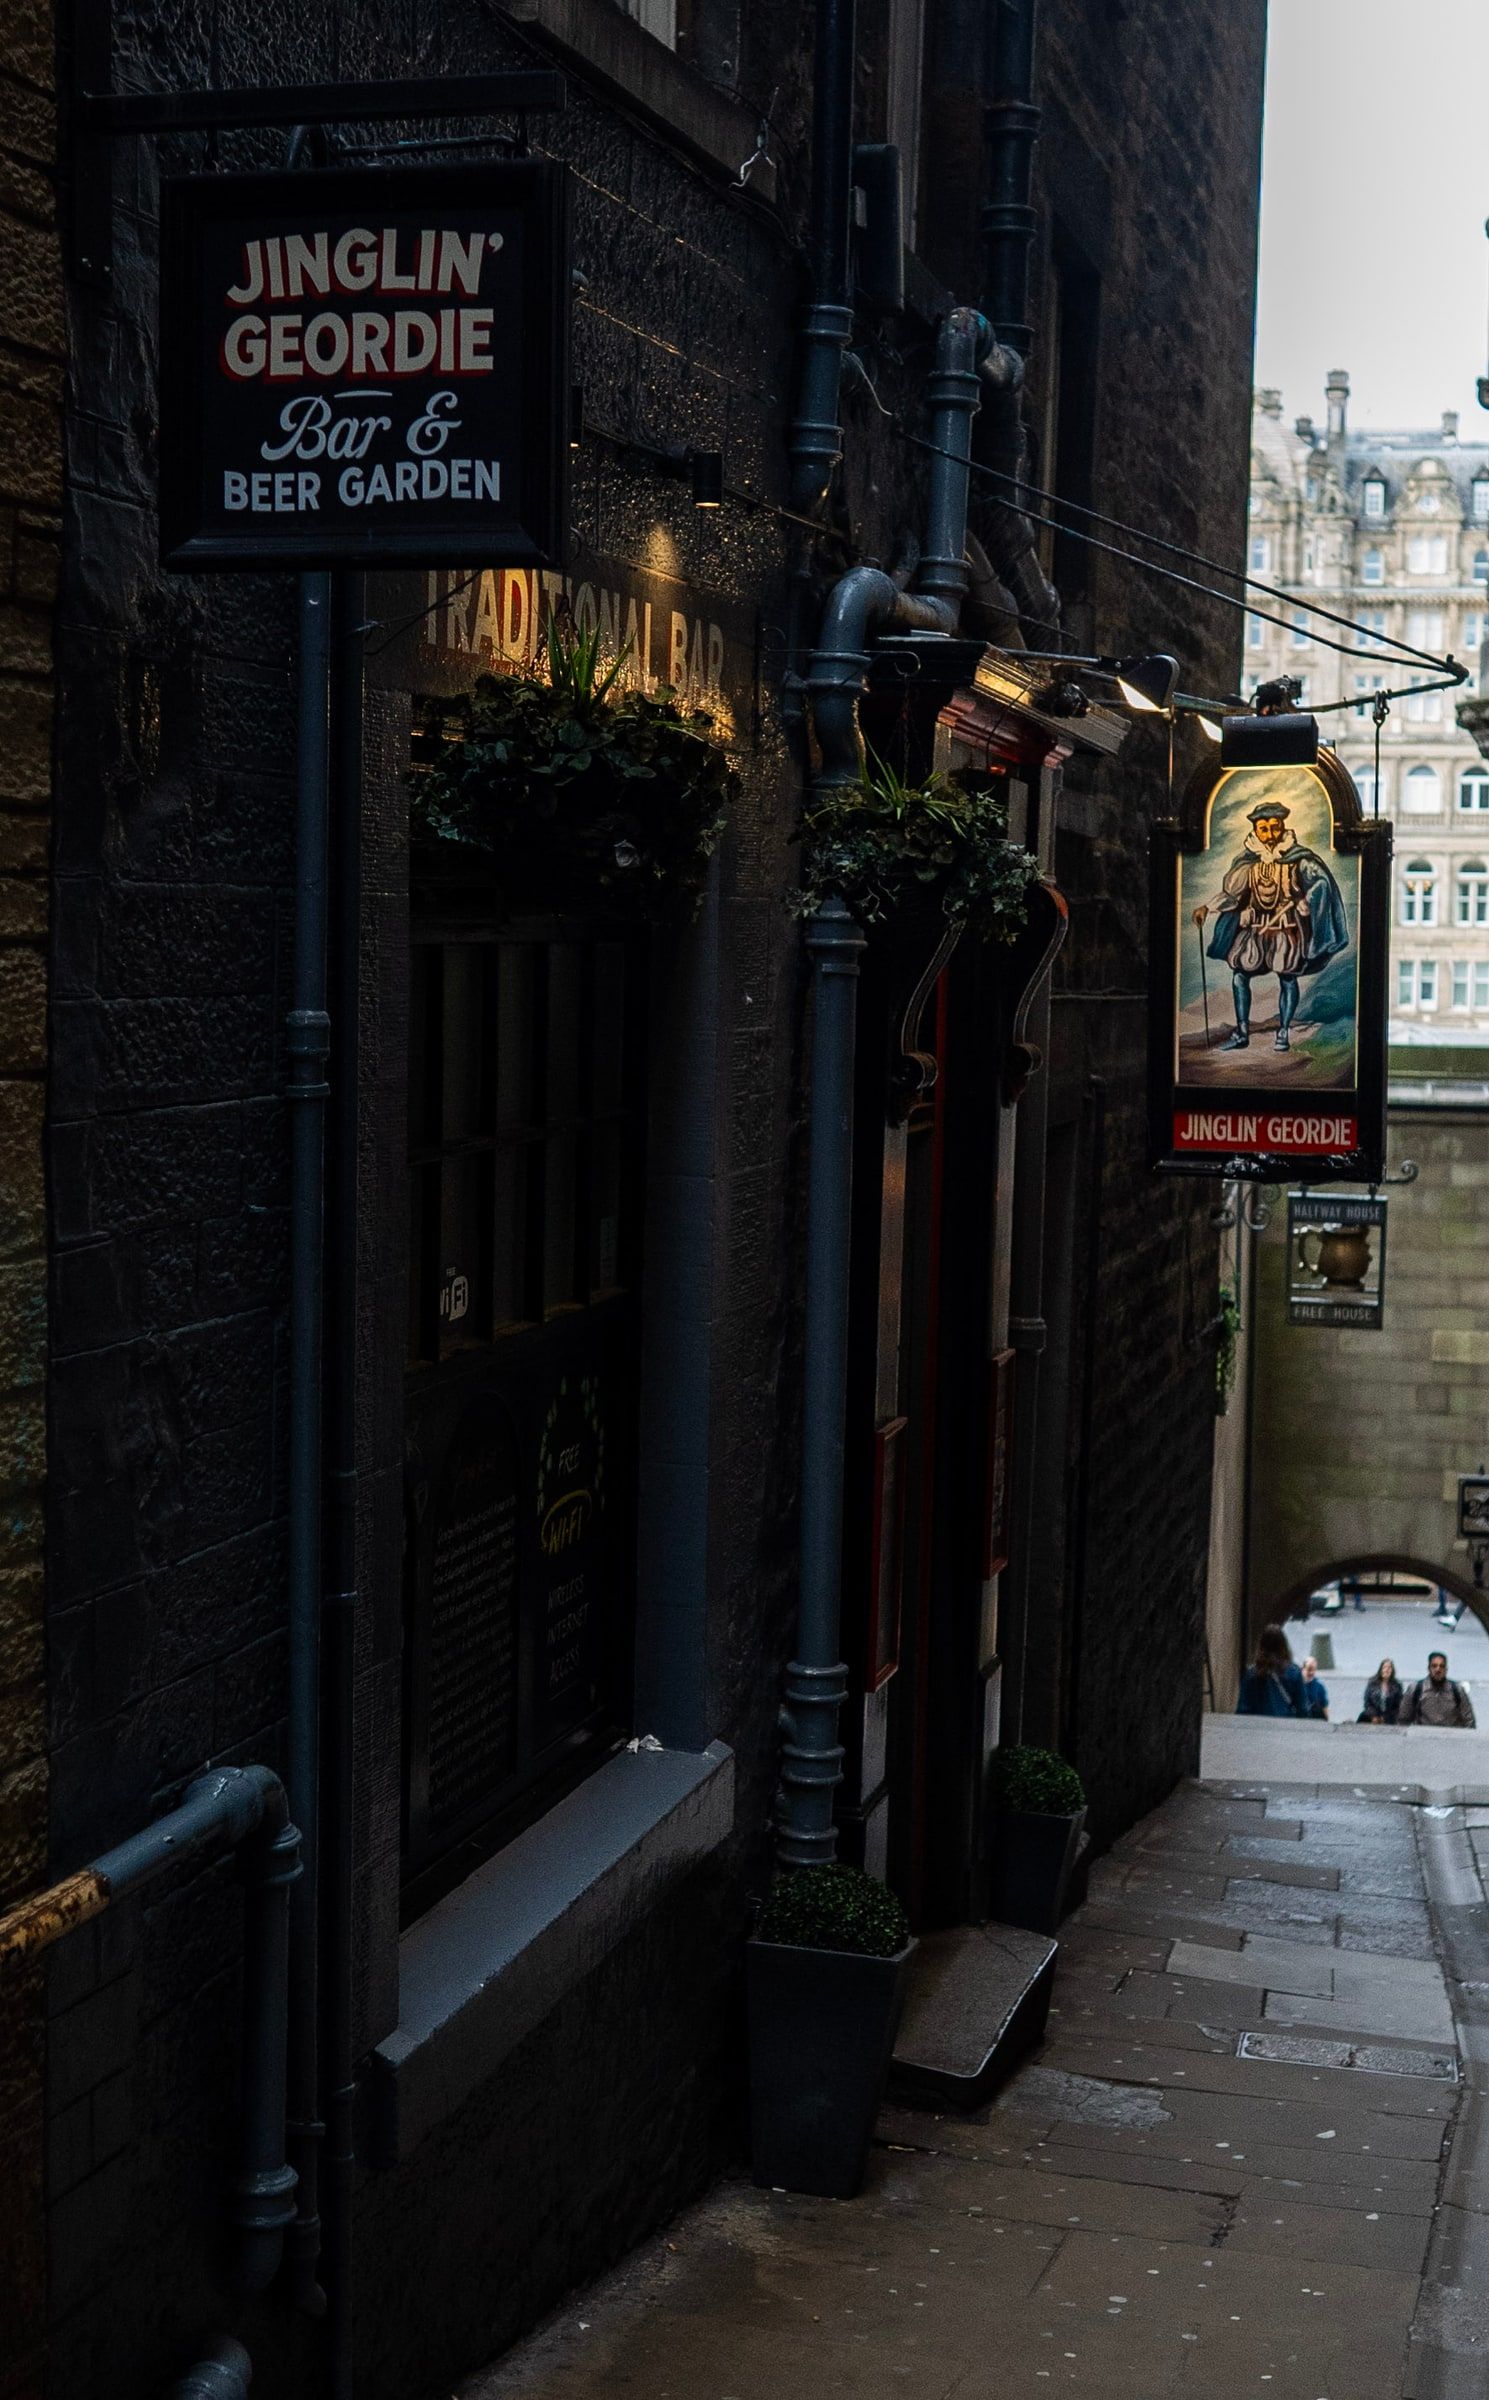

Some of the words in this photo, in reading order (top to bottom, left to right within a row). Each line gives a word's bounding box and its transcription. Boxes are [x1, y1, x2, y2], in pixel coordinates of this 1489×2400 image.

[224, 228, 504, 305] JINGLIN'
[221, 308, 494, 379] GEORDIE
[261, 395, 391, 461] Bar
[406, 391, 462, 455] &
[223, 470, 321, 512] BEER
[338, 459, 500, 505] GARDEN
[669, 610, 724, 702] BAR
[1180, 1113, 1263, 1143] JINGLIN'
[1267, 1117, 1352, 1146] GEORDIE
[1294, 1204, 1341, 1218] HALFWAY
[1345, 1205, 1380, 1219] HOUSE
[1294, 1307, 1323, 1319] FREE
[1334, 1307, 1371, 1321] HOUSE
